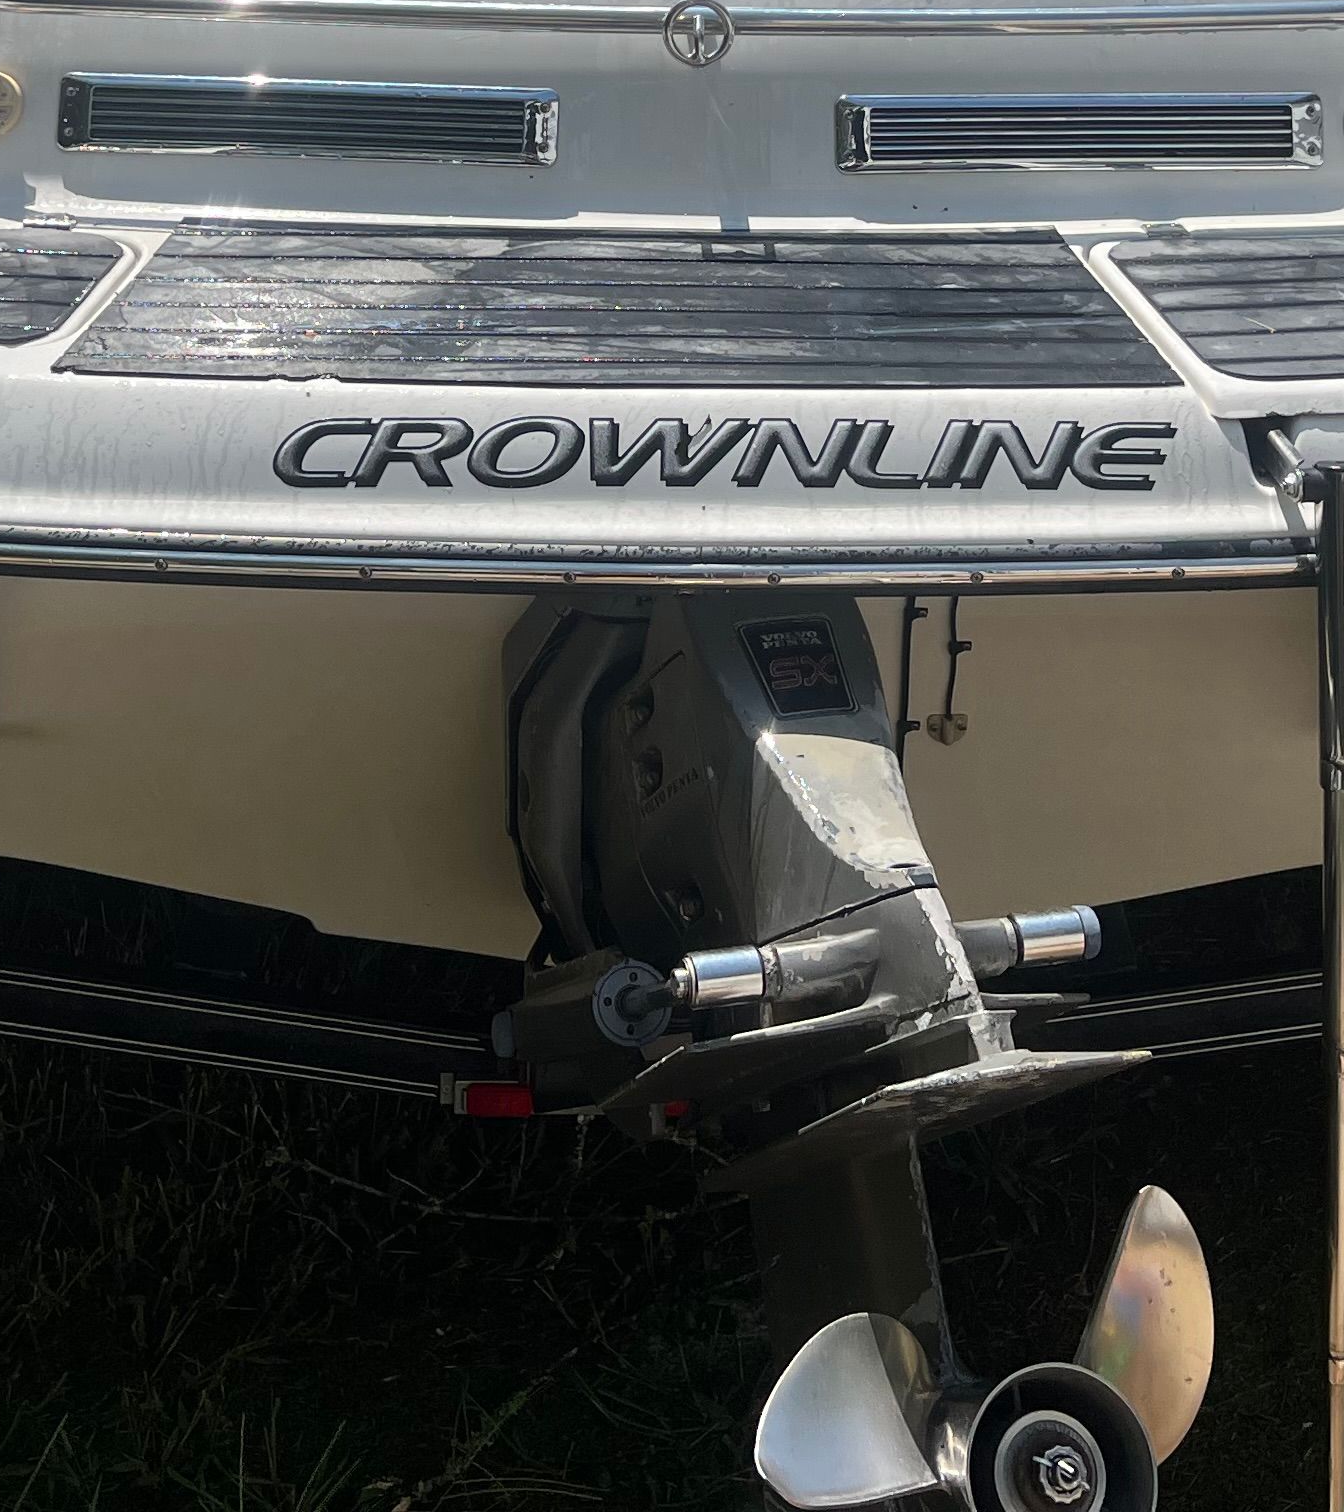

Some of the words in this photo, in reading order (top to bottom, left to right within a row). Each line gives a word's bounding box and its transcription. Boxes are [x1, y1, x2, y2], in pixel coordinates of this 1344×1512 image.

[272, 415, 1178, 491] CROWNLINE
[760, 630, 818, 642] VOLVO
[762, 638, 823, 649] PENTA
[769, 654, 838, 691] SX
